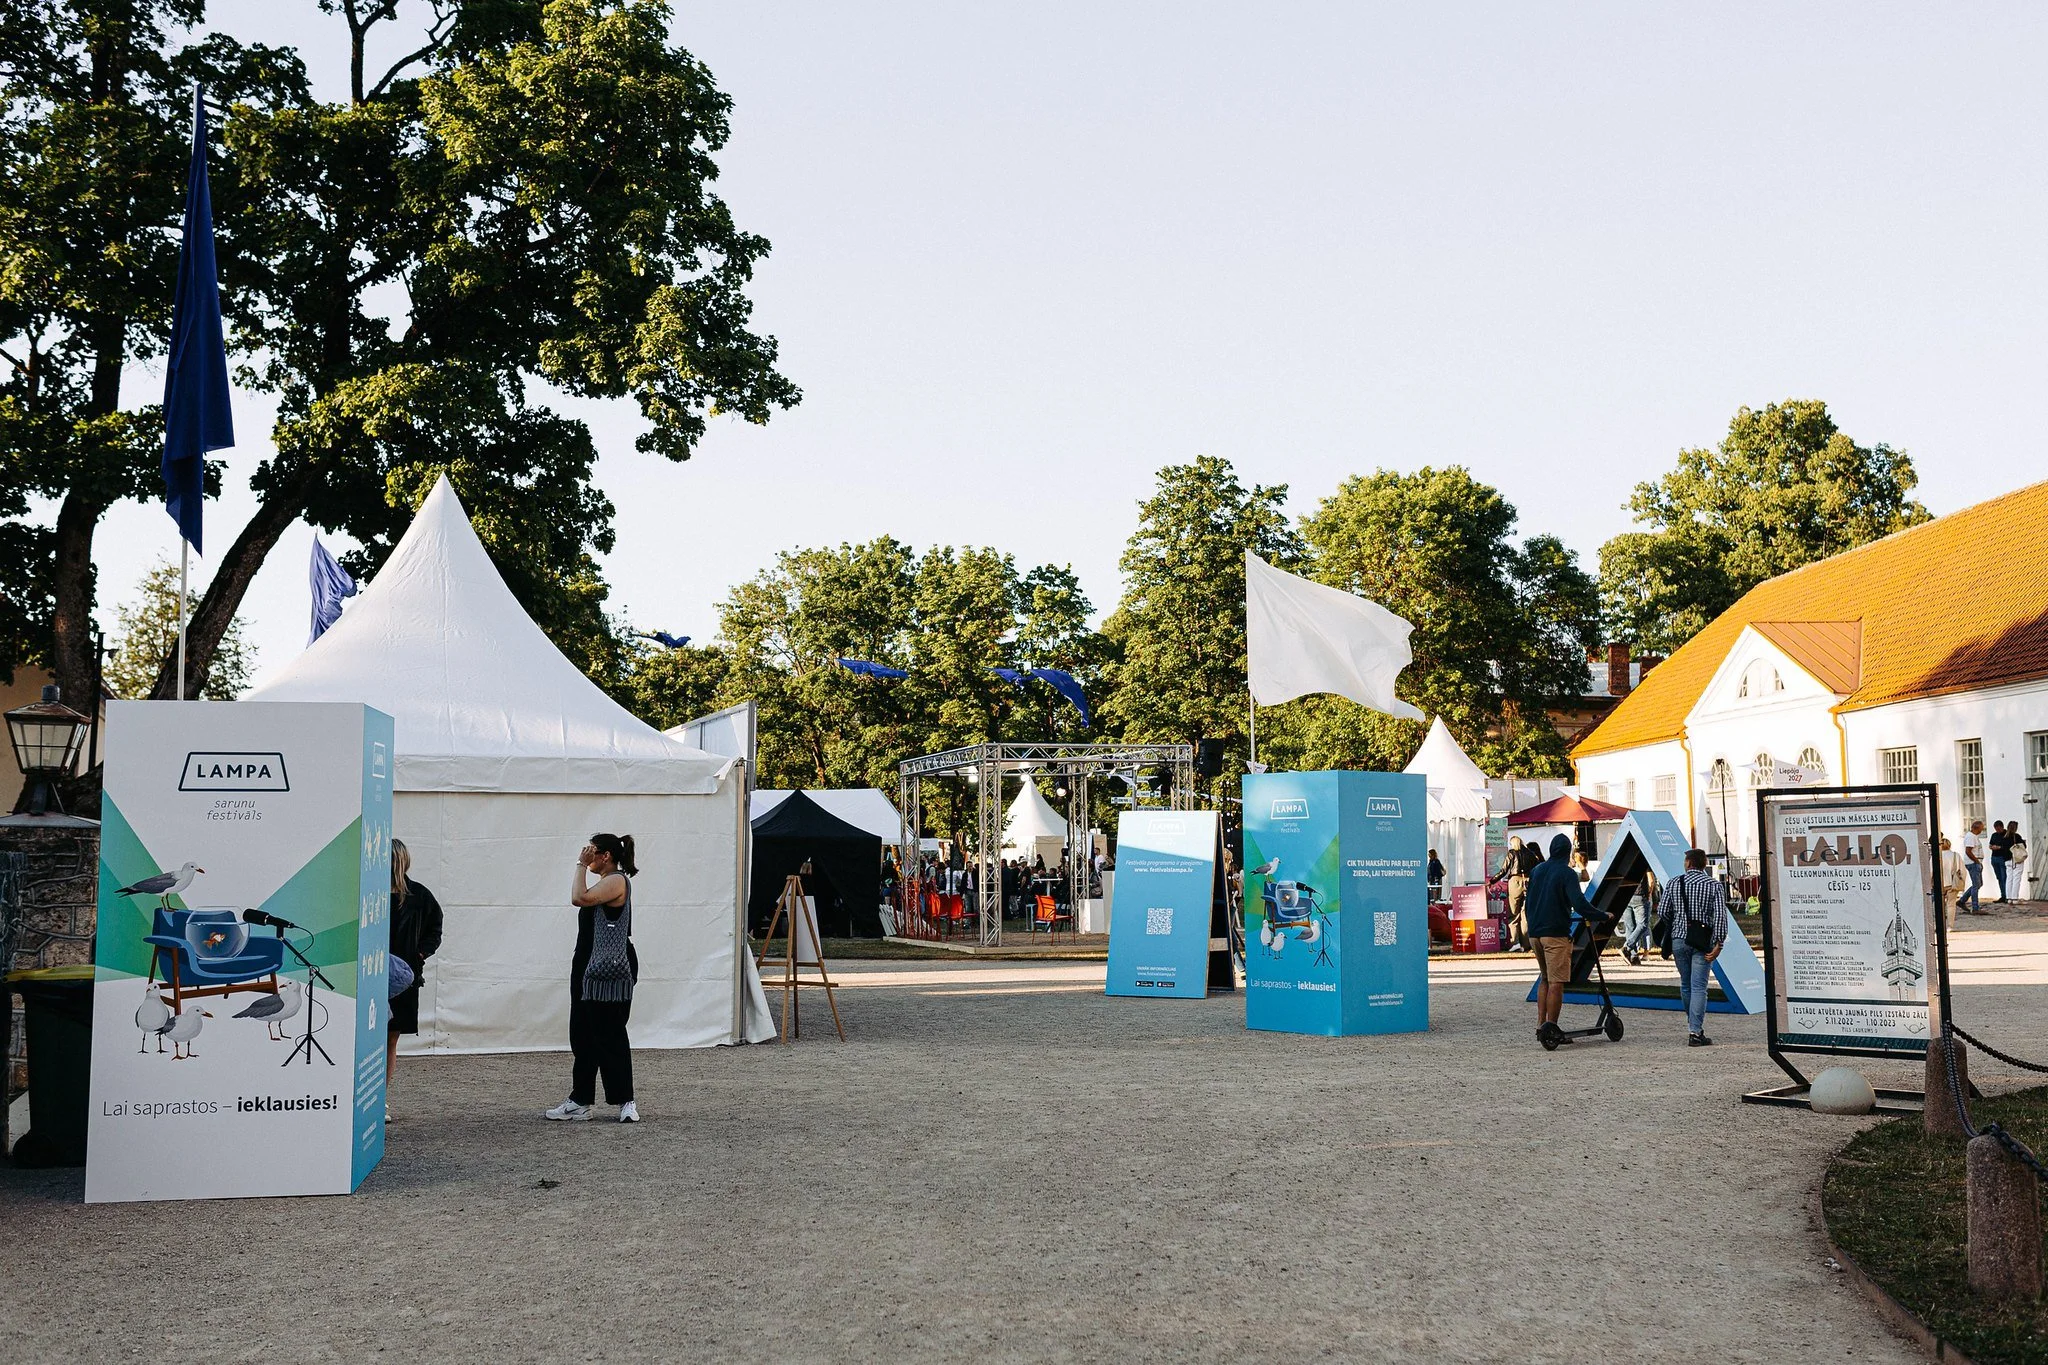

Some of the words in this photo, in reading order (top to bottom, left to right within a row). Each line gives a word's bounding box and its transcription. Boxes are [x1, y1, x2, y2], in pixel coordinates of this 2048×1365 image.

[197, 764, 272, 779] LAMPA
[1788, 775, 1803, 783] 2027
[214, 800, 256, 809] sarunu
[1276, 804, 1303, 813] LAMPA
[1371, 803, 1396, 812] LAMPA
[206, 810, 262, 821] festivāls
[1802, 816, 1834, 824] VĒSTURES
[1848, 814, 1878, 822] MĀKSLAS
[1881, 813, 1908, 822] MUZEJĀ
[1347, 859, 1357, 867] CIK
[1357, 859, 1365, 867] TU
[1365, 858, 1391, 867] MAKSĀTU
[1391, 859, 1401, 867] PAR
[1352, 869, 1372, 877] ZIEDO,
[1371, 869, 1381, 877] LAI
[1380, 868, 1416, 877] TURPINĀTOS!
[1789, 868, 1854, 878] TELEKOMUNIKĀCIJU
[1858, 867, 1891, 877] VĒSTUREI
[1859, 882, 1872, 891] 125
[1480, 932, 1496, 940] 2024
[1250, 978, 1260, 987] Lai
[1260, 980, 1292, 989] saprastos
[1297, 981, 1336, 992] ieklausies!
[1792, 1007, 1816, 1015] IZSTĀDE
[1818, 1008, 1843, 1016] ATVĒRTA
[1845, 1009, 1868, 1017] JAUNĀS
[1885, 1010, 1911, 1018] IZSTĀŽU
[1825, 1017, 1854, 1026] 5.11.2022
[1866, 1019, 1896, 1027] 1.10.2023
[103, 1100, 128, 1116] Lai
[133, 1099, 218, 1119] saprastos
[237, 1094, 338, 1113] ieklausies!
